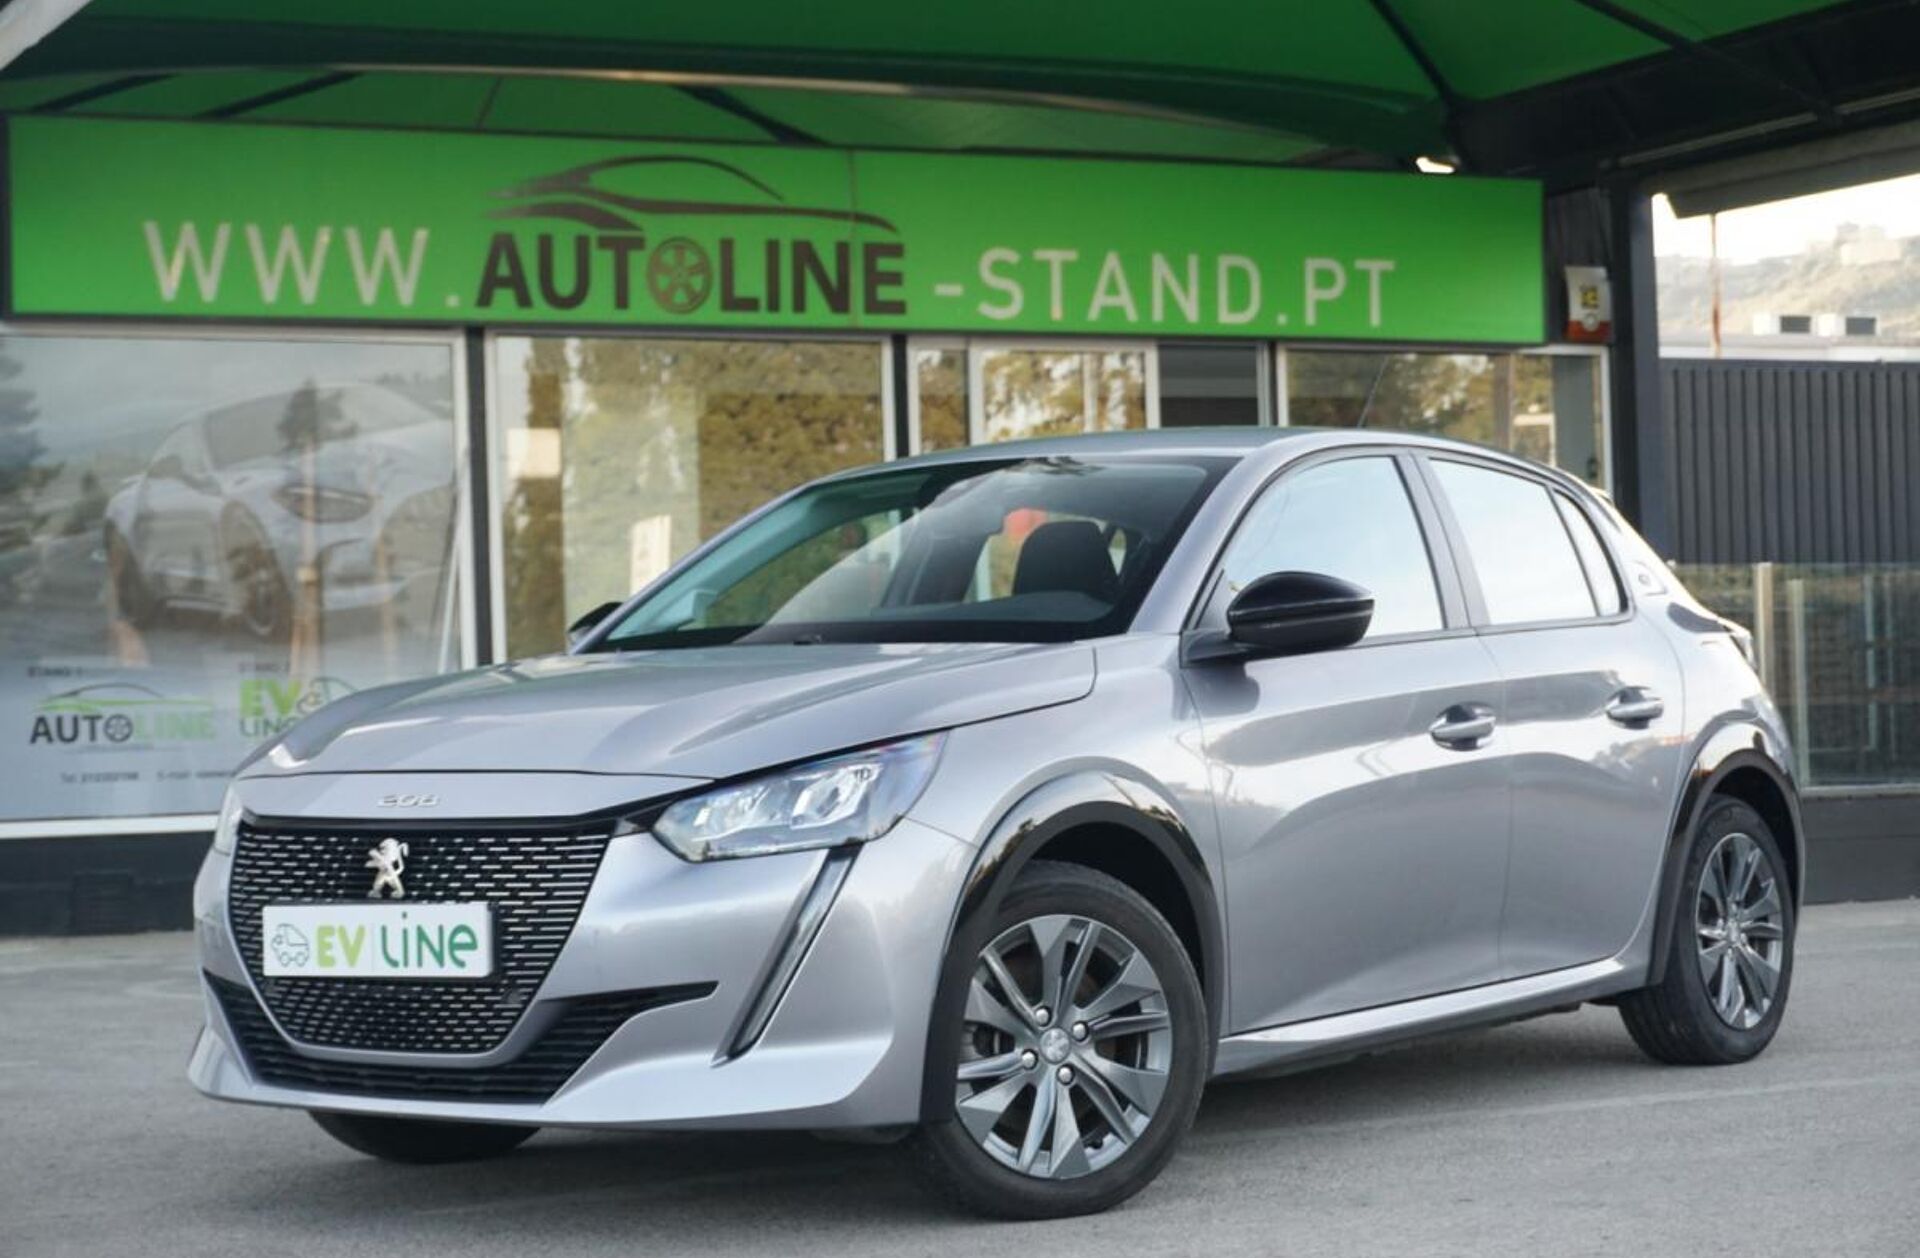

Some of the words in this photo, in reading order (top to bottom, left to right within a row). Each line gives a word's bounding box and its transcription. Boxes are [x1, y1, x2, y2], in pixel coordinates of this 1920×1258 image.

[476, 231, 907, 316] AUTOLINE
[239, 679, 302, 718] EV
[30, 713, 215, 744] AUTOLINE
[315, 924, 366, 969] EV
